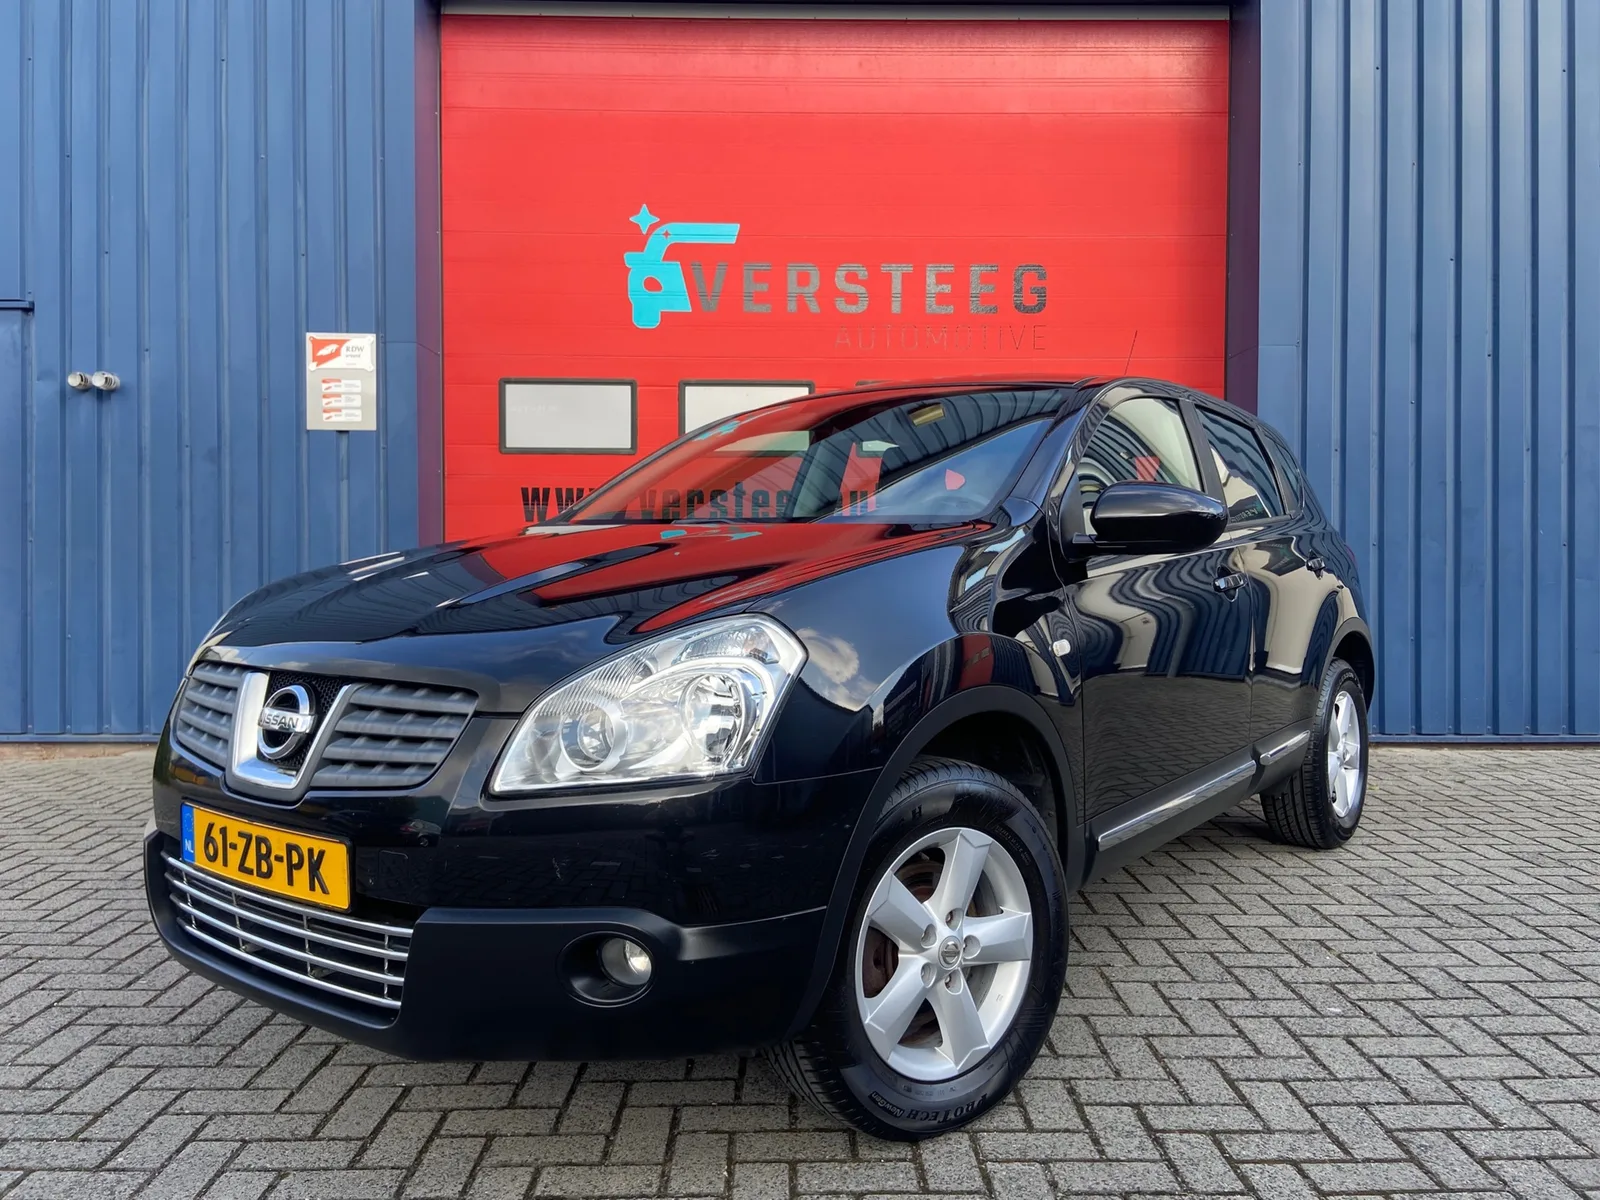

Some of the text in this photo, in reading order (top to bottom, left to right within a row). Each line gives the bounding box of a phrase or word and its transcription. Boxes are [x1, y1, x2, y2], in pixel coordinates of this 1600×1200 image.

[691, 262, 1047, 314] VERSTEEG
[345, 345, 365, 353] RDW
[835, 324, 1047, 350] AUTOMOTIVE
[184, 838, 194, 853] NL
[204, 822, 330, 895] 61-ZB-PK
[870, 1092, 904, 1117] NewGen
